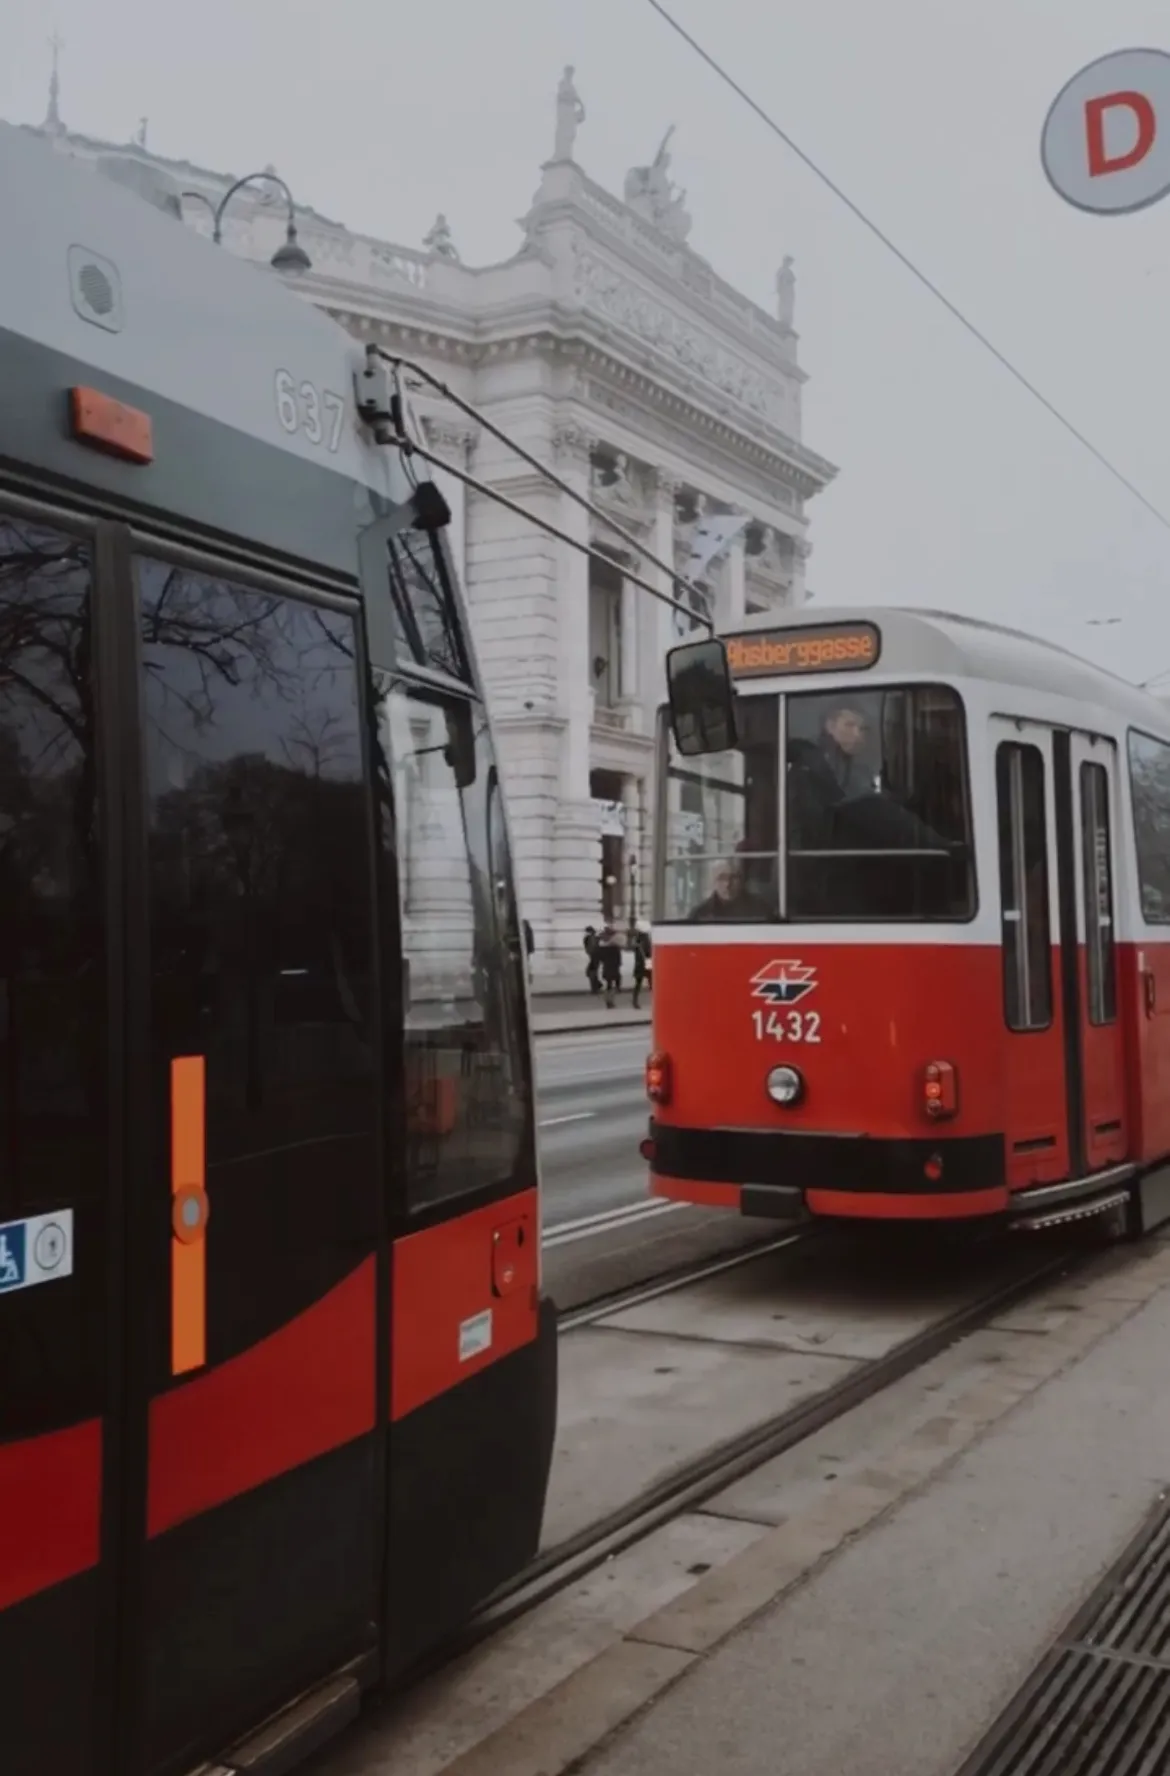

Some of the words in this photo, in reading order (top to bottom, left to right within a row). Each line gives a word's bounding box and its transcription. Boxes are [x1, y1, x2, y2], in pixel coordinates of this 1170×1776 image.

[1085, 91, 1155, 177] D
[275, 367, 344, 453] 637
[752, 1010, 821, 1042] 1432
